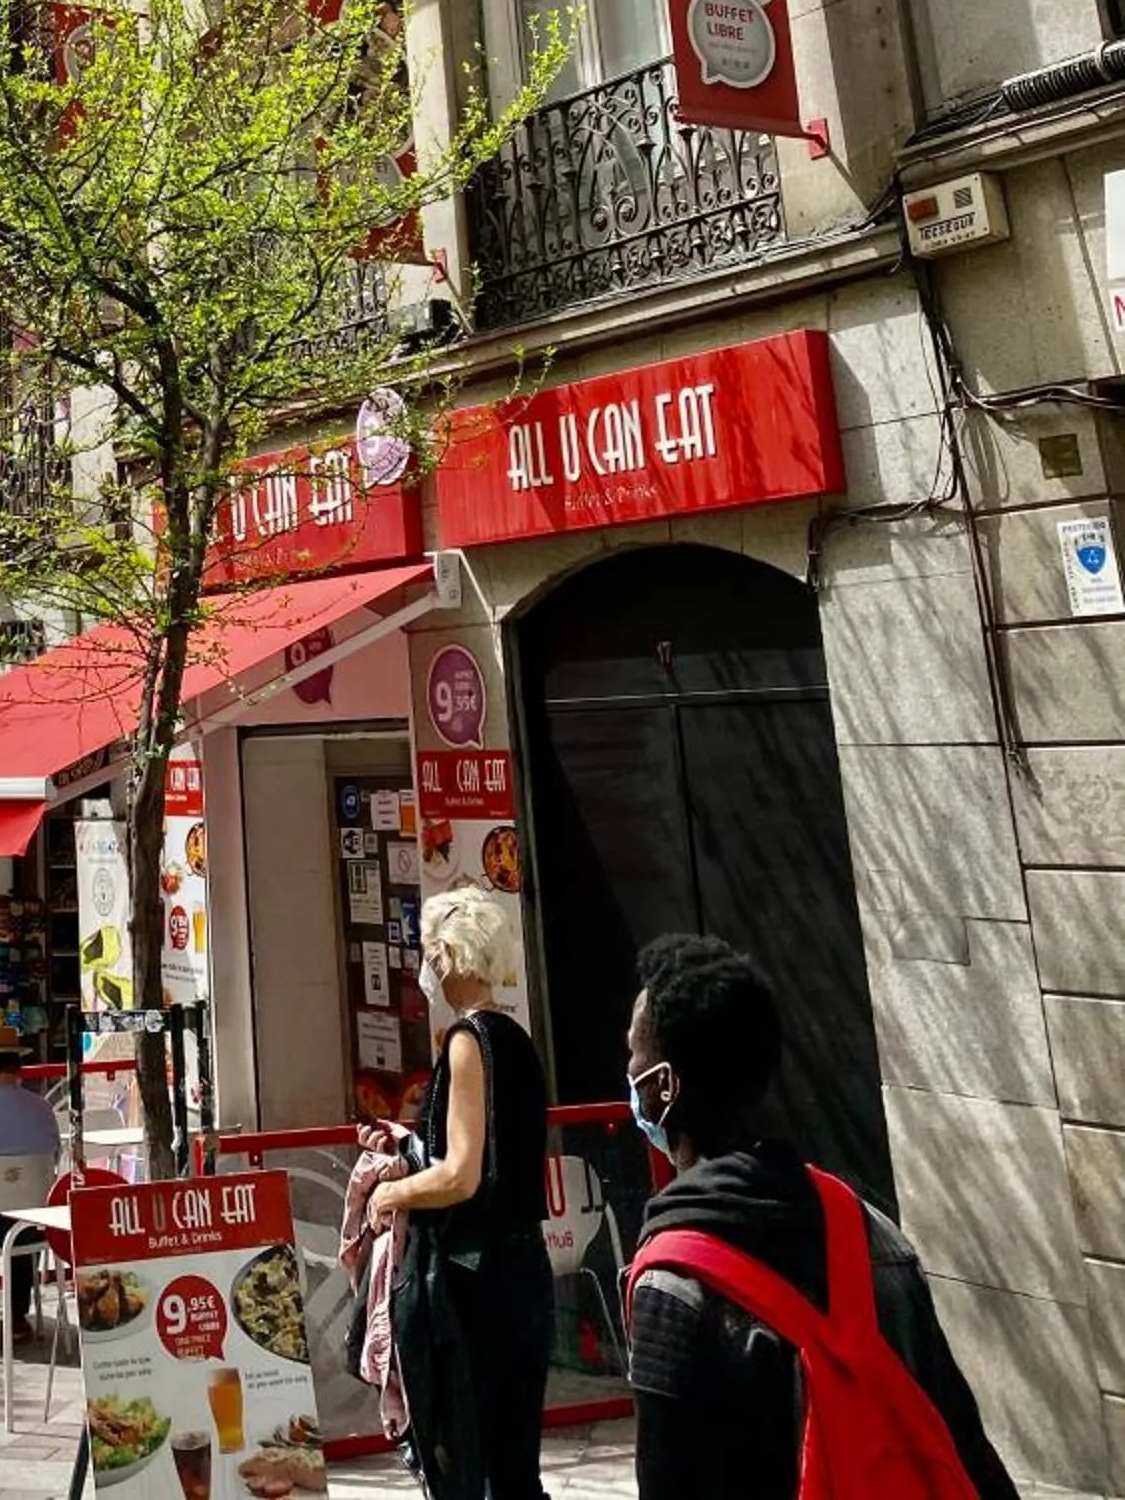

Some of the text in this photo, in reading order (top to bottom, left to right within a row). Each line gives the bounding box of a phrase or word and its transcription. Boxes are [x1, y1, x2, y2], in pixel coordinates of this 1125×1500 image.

[704, 2, 756, 23] BUFFET
[707, 20, 745, 41] LIBRE
[507, 383, 717, 491] ALL U CAN EAT
[422, 758, 506, 793] ALL CAN EAT
[109, 1183, 256, 1237] ALL U CAN EAT
[148, 1231, 222, 1249] Buffet & Drinks
